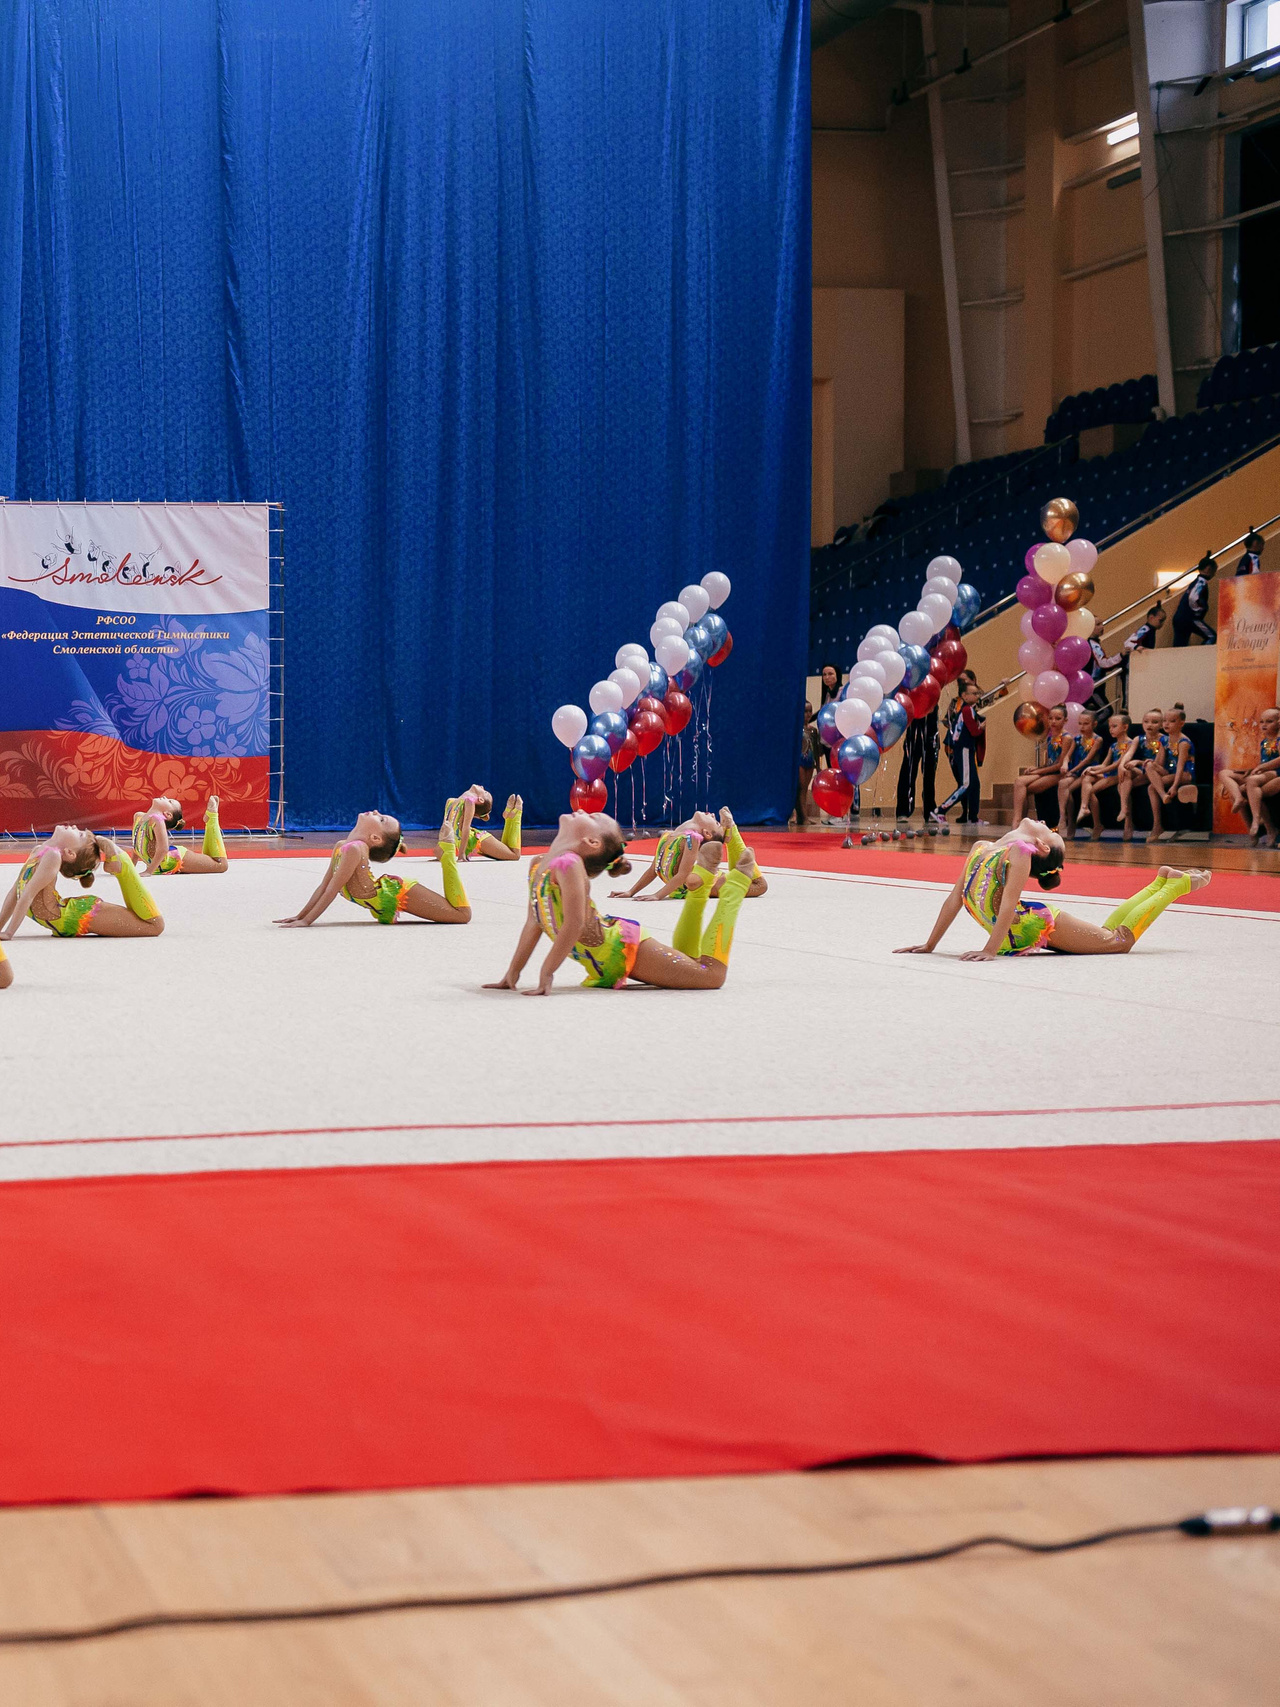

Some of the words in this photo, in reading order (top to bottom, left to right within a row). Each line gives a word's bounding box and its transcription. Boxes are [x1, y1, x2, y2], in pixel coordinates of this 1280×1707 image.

[96, 615, 136, 626] РФСОО
[1, 629, 69, 642] «Федерация
[71, 630, 154, 641] Эстетической
[157, 630, 230, 641] Гимнастики
[53, 644, 122, 655] Смоленской
[124, 644, 180, 655] области»
